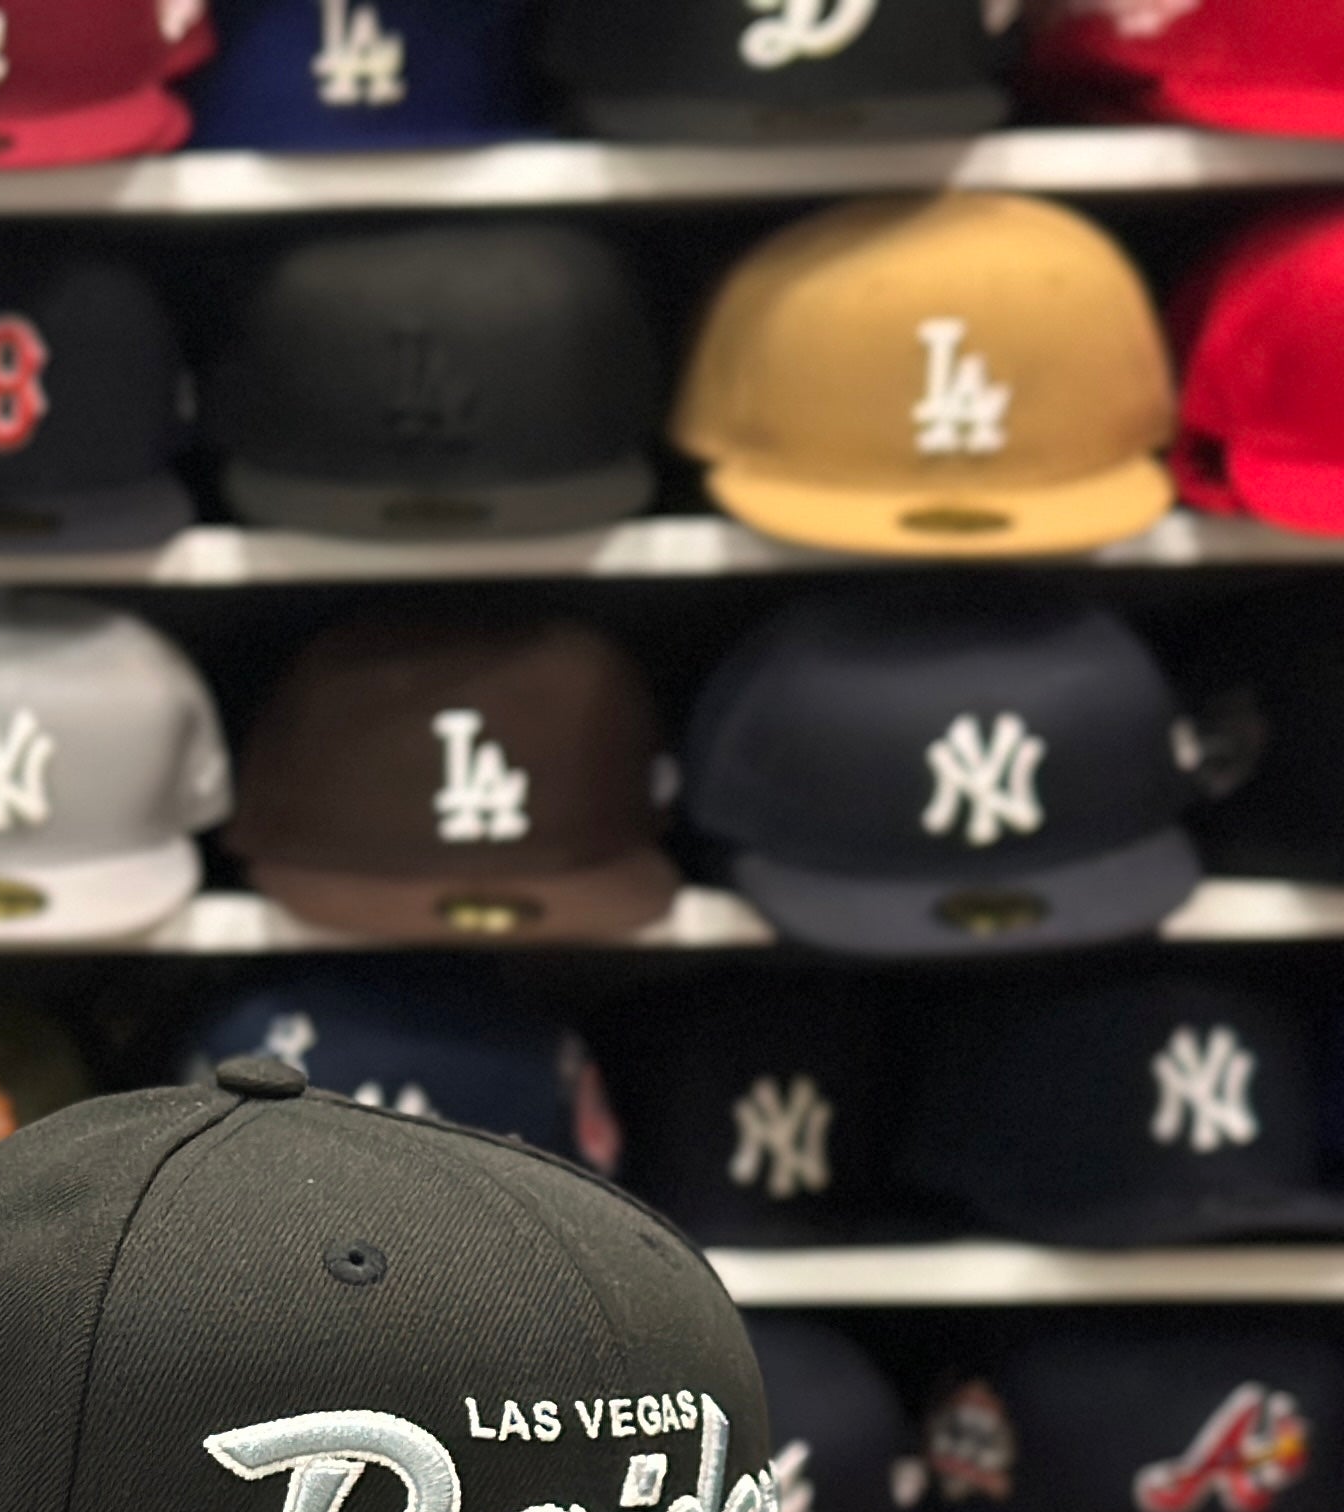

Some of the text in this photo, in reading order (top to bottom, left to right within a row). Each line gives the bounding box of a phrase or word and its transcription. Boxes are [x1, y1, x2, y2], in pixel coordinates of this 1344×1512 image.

[911, 317, 1011, 453] LA
[432, 709, 530, 841] LA
[922, 711, 1046, 846] NY
[1149, 1026, 1259, 1155] NY
[465, 1389, 698, 1441] LAS VEGAS
